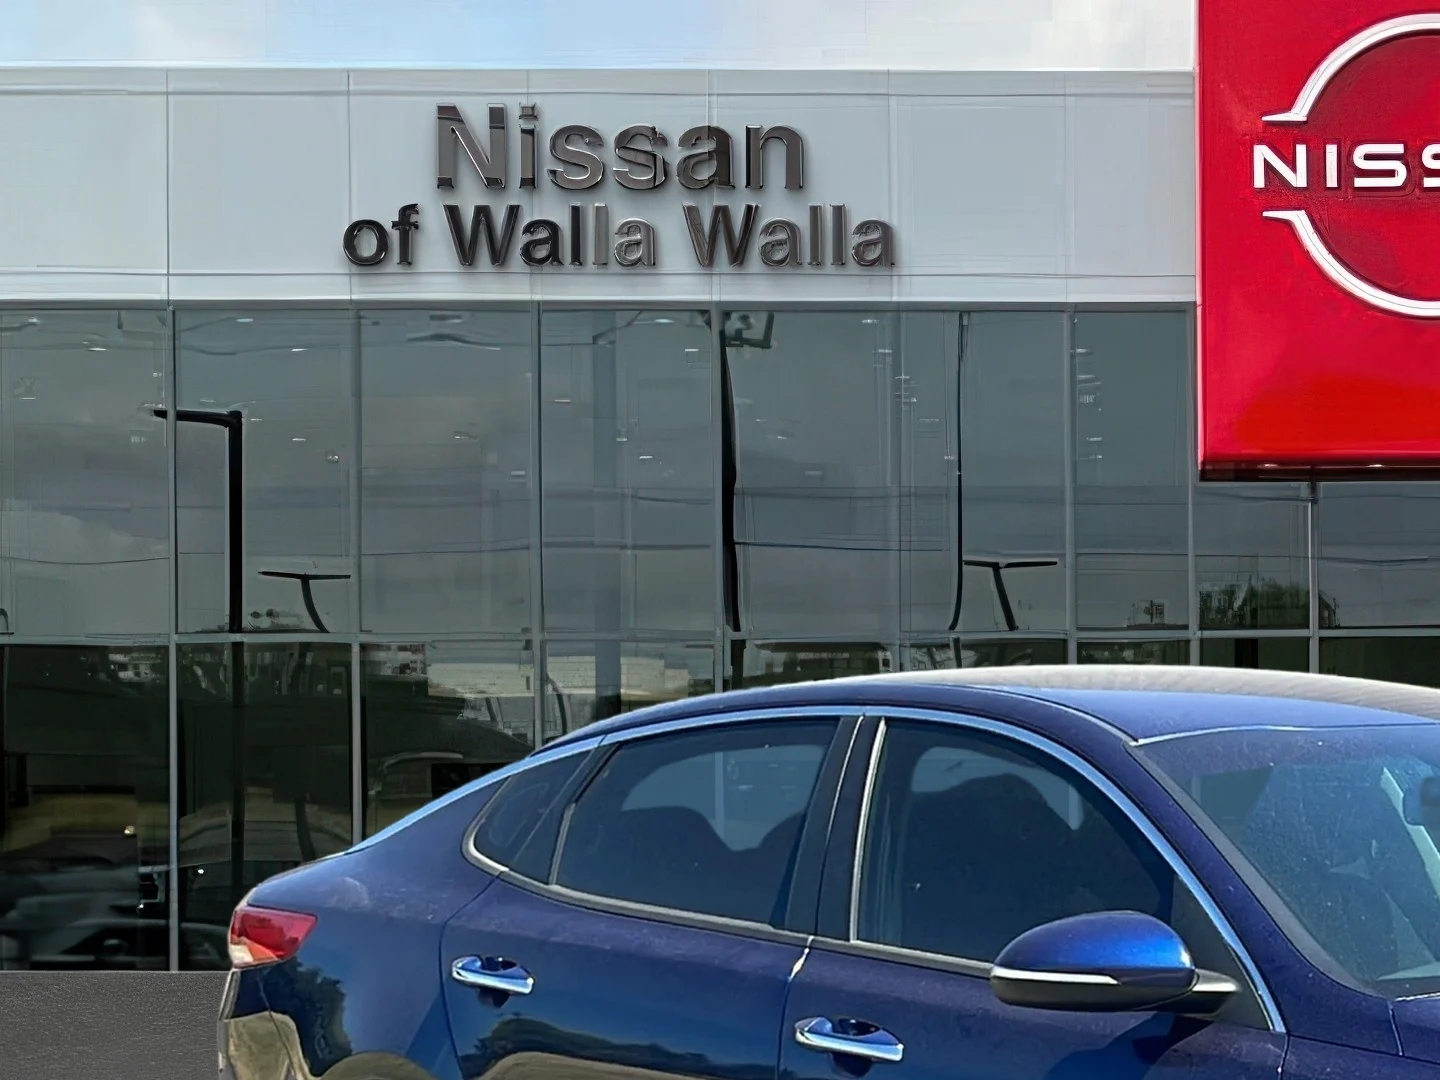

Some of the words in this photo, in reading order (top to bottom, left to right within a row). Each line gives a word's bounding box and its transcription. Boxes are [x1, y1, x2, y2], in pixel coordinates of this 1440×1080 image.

[436, 102, 804, 190] Nissan
[342, 202, 421, 266] of
[443, 202, 657, 267] Walla
[682, 202, 896, 267] Walla
